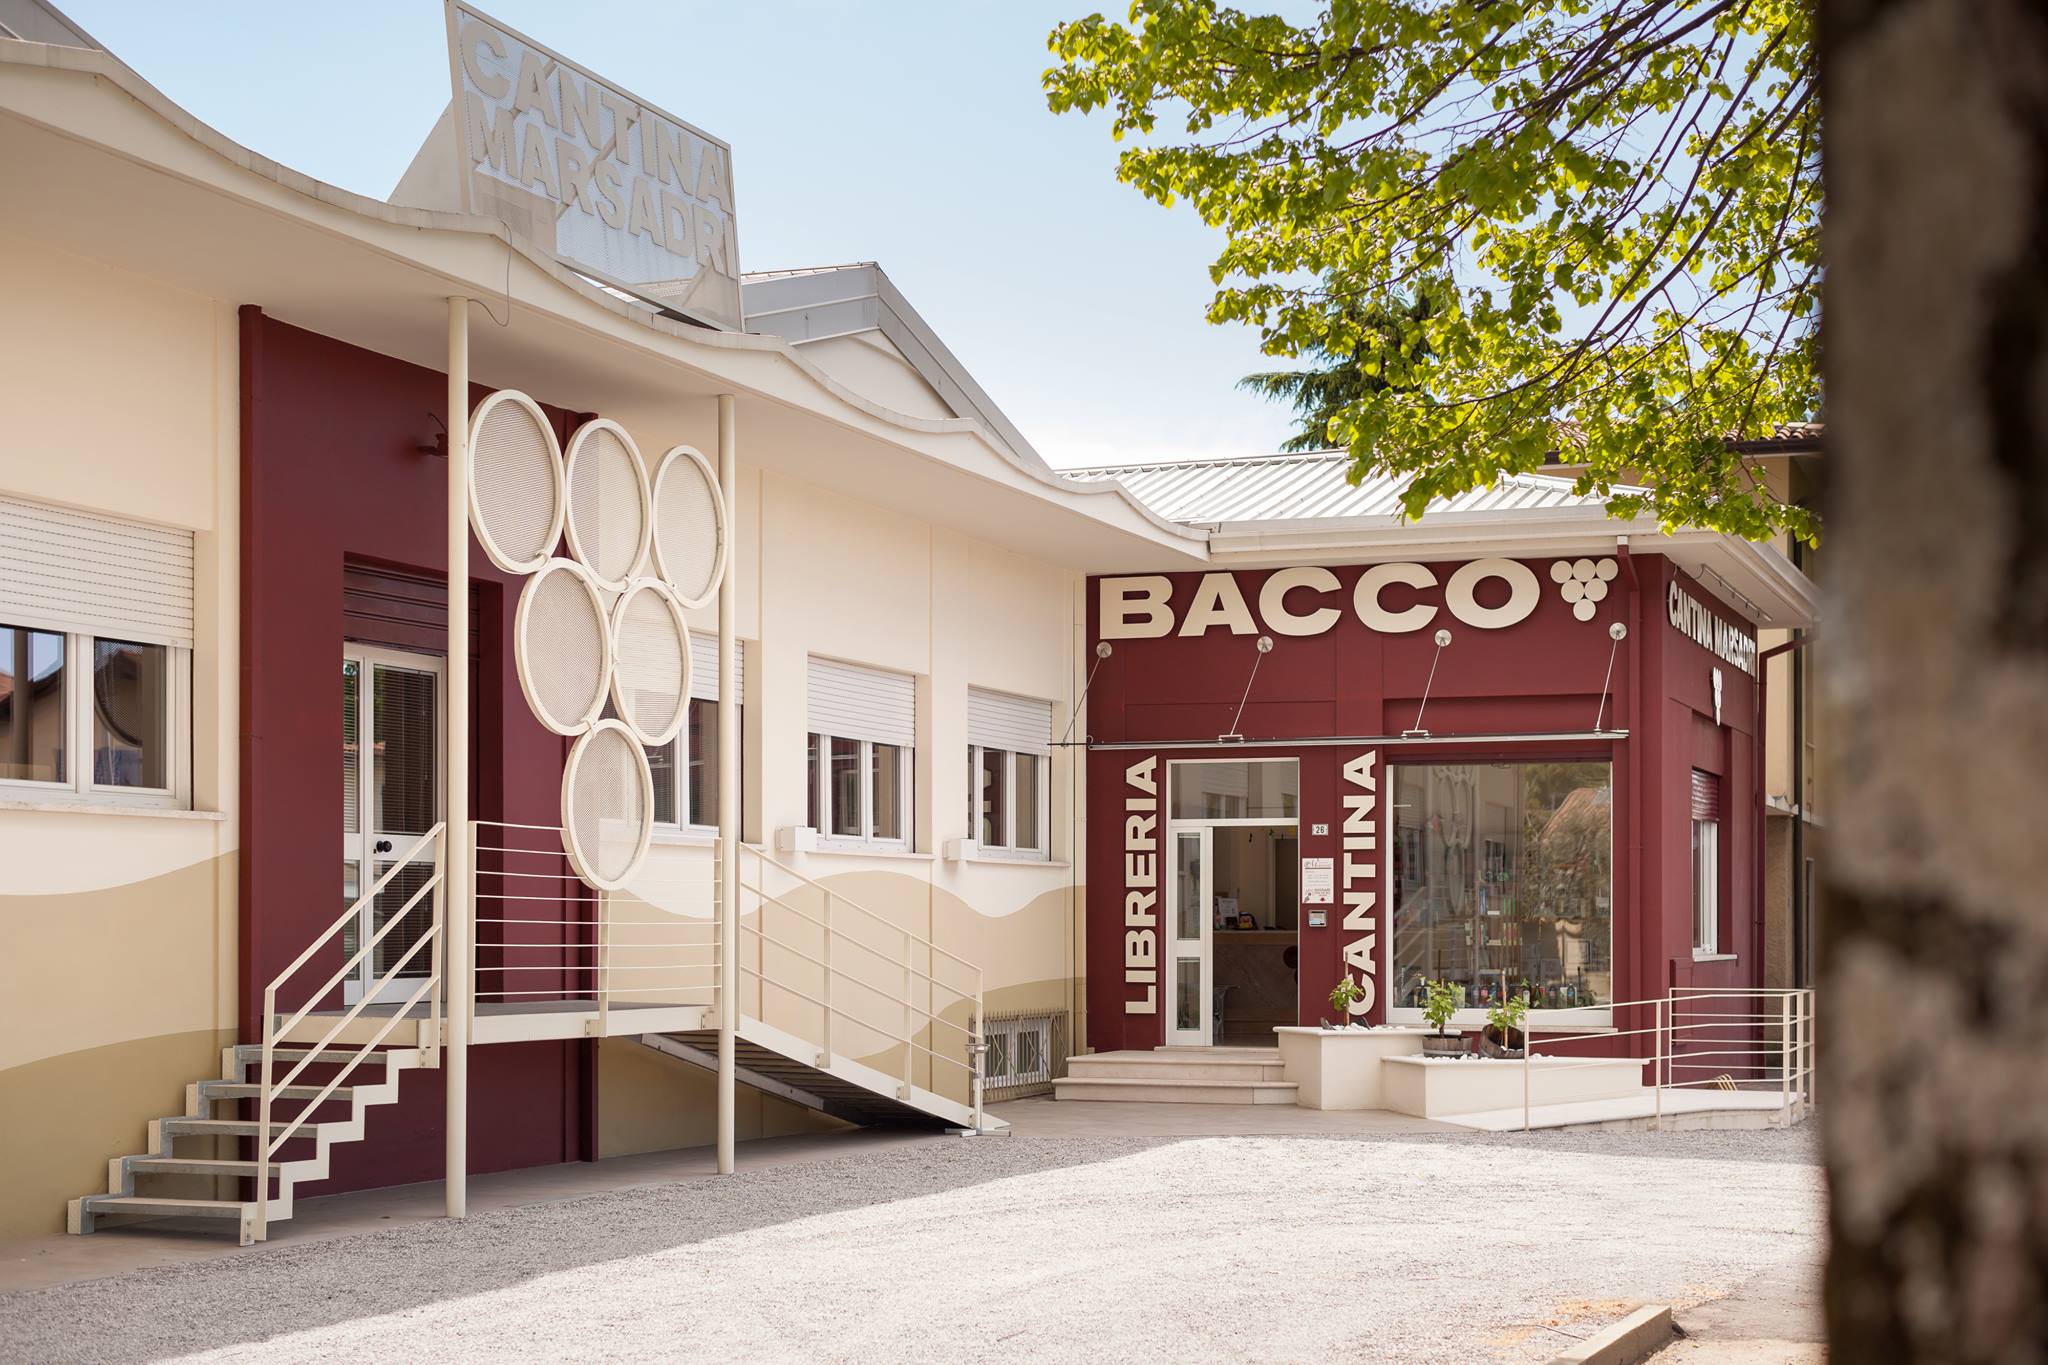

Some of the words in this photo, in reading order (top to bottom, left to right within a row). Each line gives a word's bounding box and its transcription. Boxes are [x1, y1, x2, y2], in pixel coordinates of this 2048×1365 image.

[463, 20, 731, 211] CANTINA
[468, 92, 736, 276] MARSADRI
[1099, 557, 1540, 640] BACCO
[1669, 580, 1713, 651] CANTINA
[1714, 615, 1756, 677] MARSADRI
[1125, 755, 1157, 1014] LIBRERIA
[1315, 825, 1325, 834] 26
[1343, 749, 1376, 1016] CANTINA
